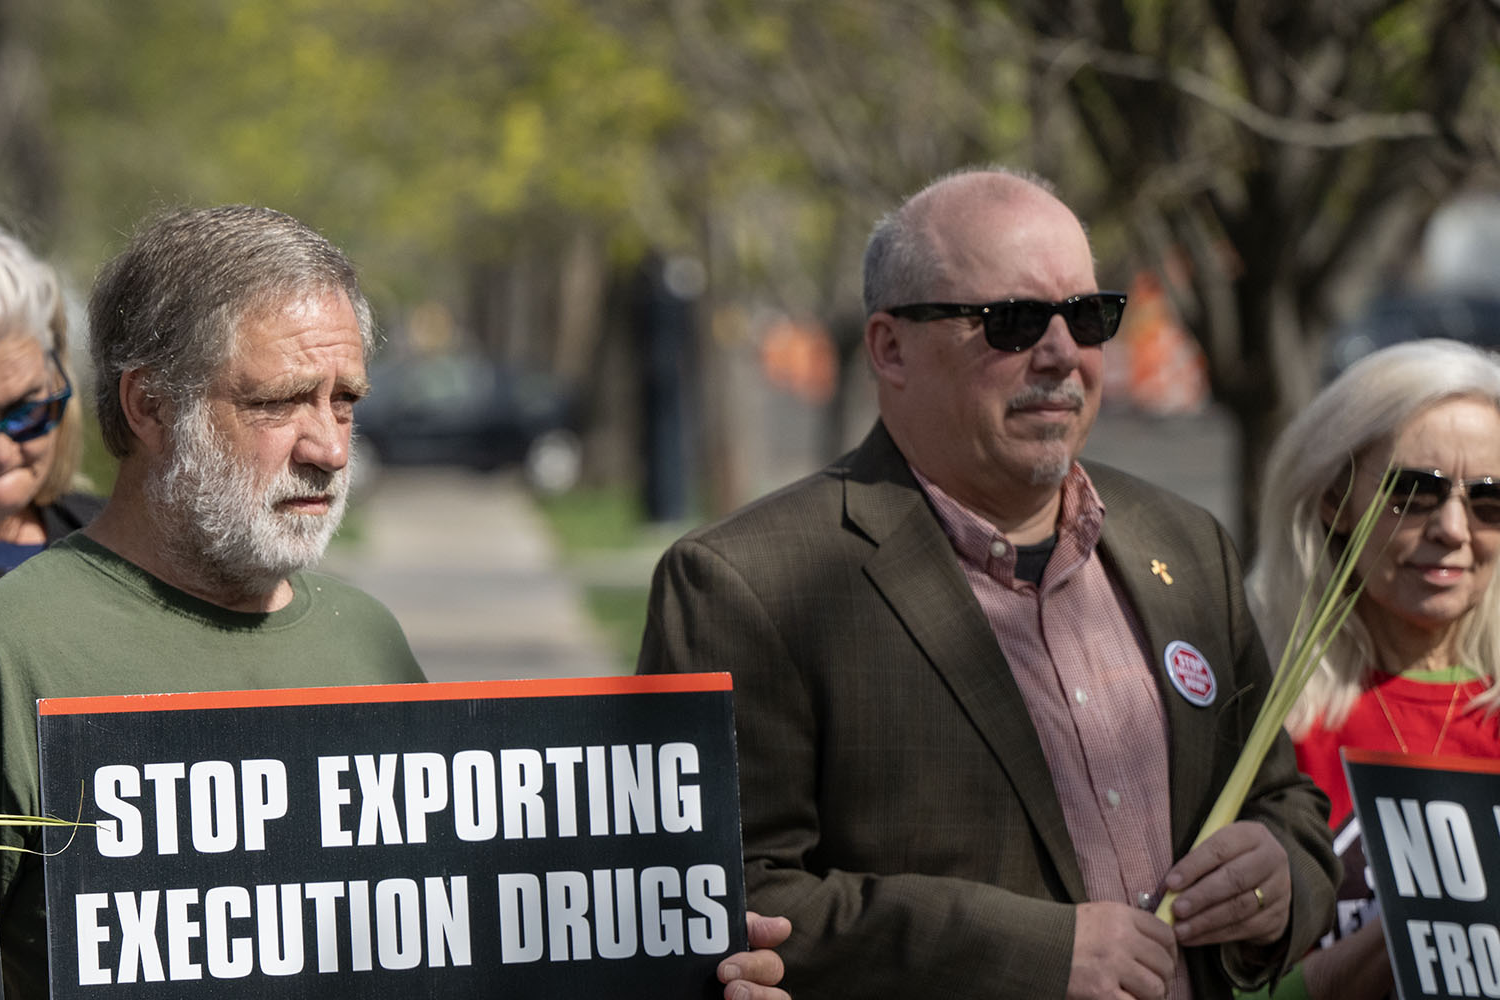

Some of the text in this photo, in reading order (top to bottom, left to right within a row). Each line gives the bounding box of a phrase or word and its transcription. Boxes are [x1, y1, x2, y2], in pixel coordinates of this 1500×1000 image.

[92, 743, 703, 858] STOP EXPORTING
[1376, 797, 1487, 901] NO
[75, 864, 731, 986] EXECUTION DRUGS
[1406, 919, 1500, 999] FRO
